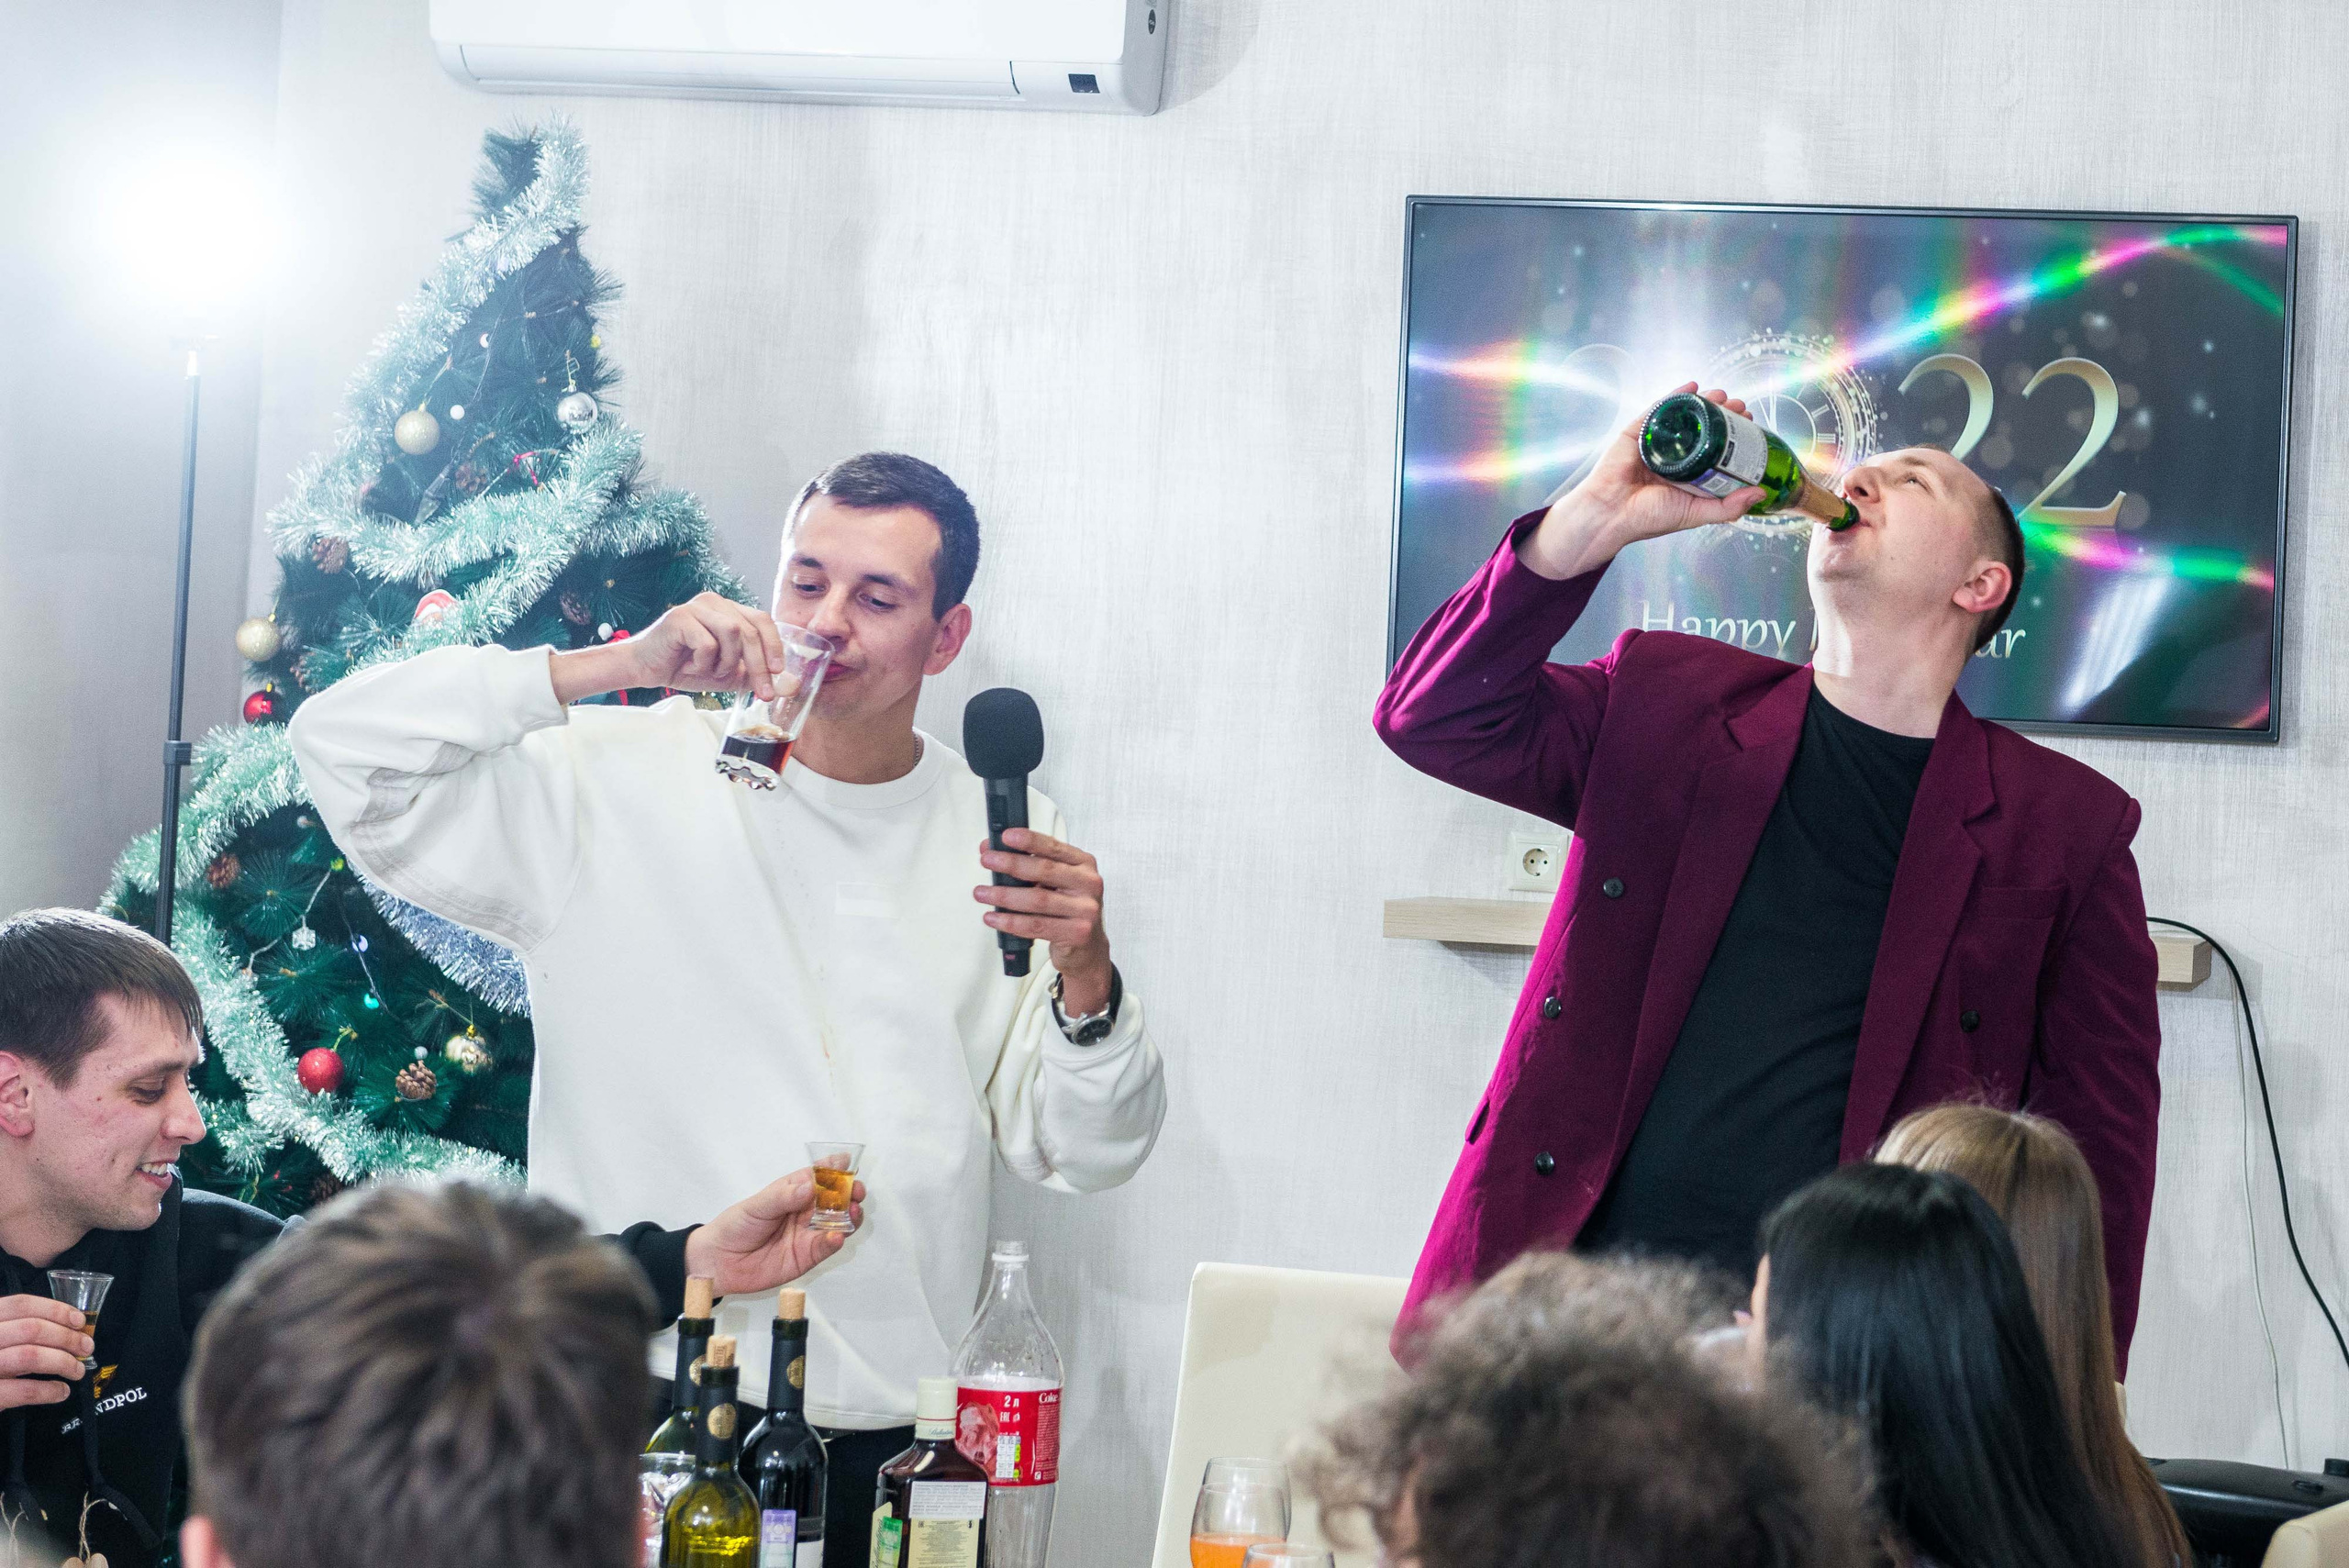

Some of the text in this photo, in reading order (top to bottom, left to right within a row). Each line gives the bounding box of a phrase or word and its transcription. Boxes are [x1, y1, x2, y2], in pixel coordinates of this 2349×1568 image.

[1974, 628, 2027, 659] ar
[1004, 1395, 1012, 1407] 2
[1039, 1392, 1059, 1405] Coke
